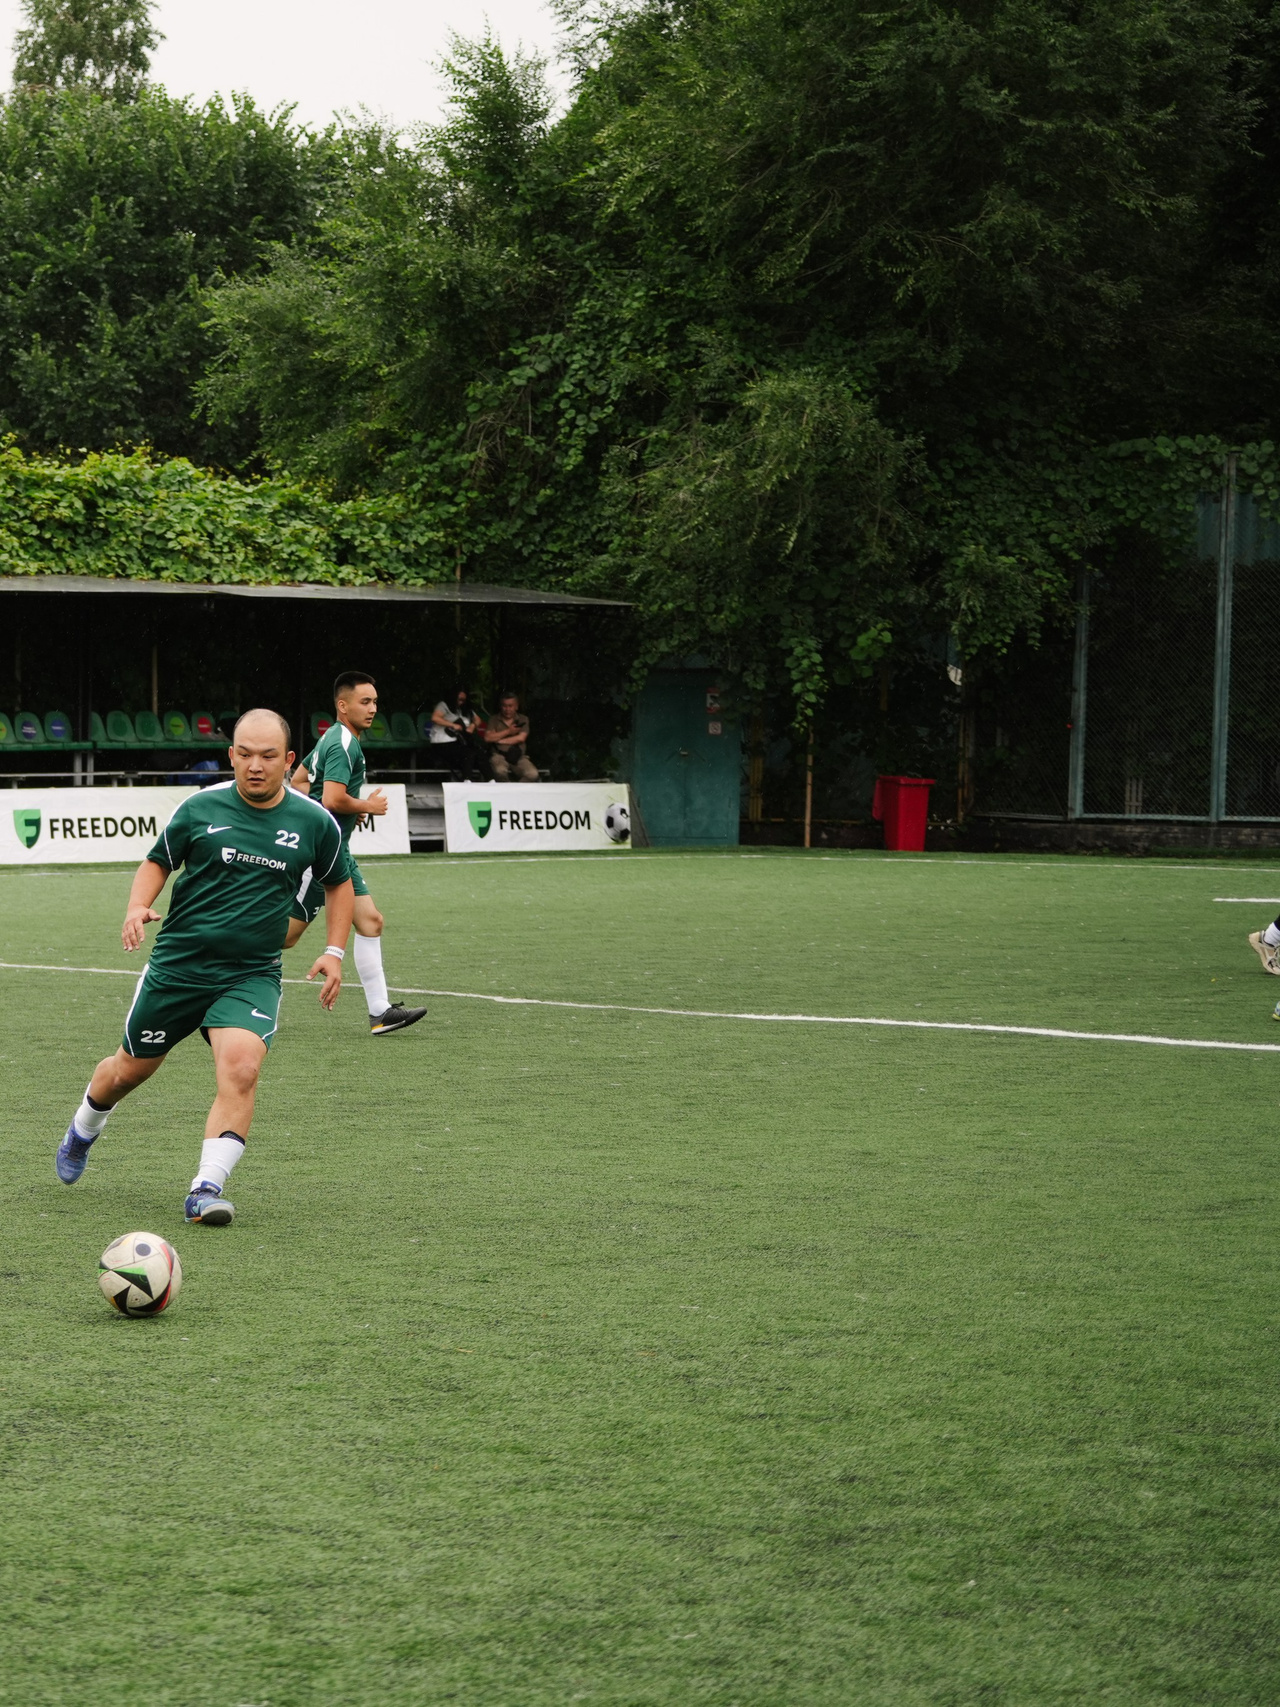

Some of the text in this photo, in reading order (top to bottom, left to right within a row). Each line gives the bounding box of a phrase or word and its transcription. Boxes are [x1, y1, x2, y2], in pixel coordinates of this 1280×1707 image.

[49, 816, 158, 839] FREEDOM
[498, 810, 591, 831] FREEDOM
[274, 829, 300, 849] 22
[236, 853, 287, 871] FREEDOM
[140, 1030, 167, 1044] 22
